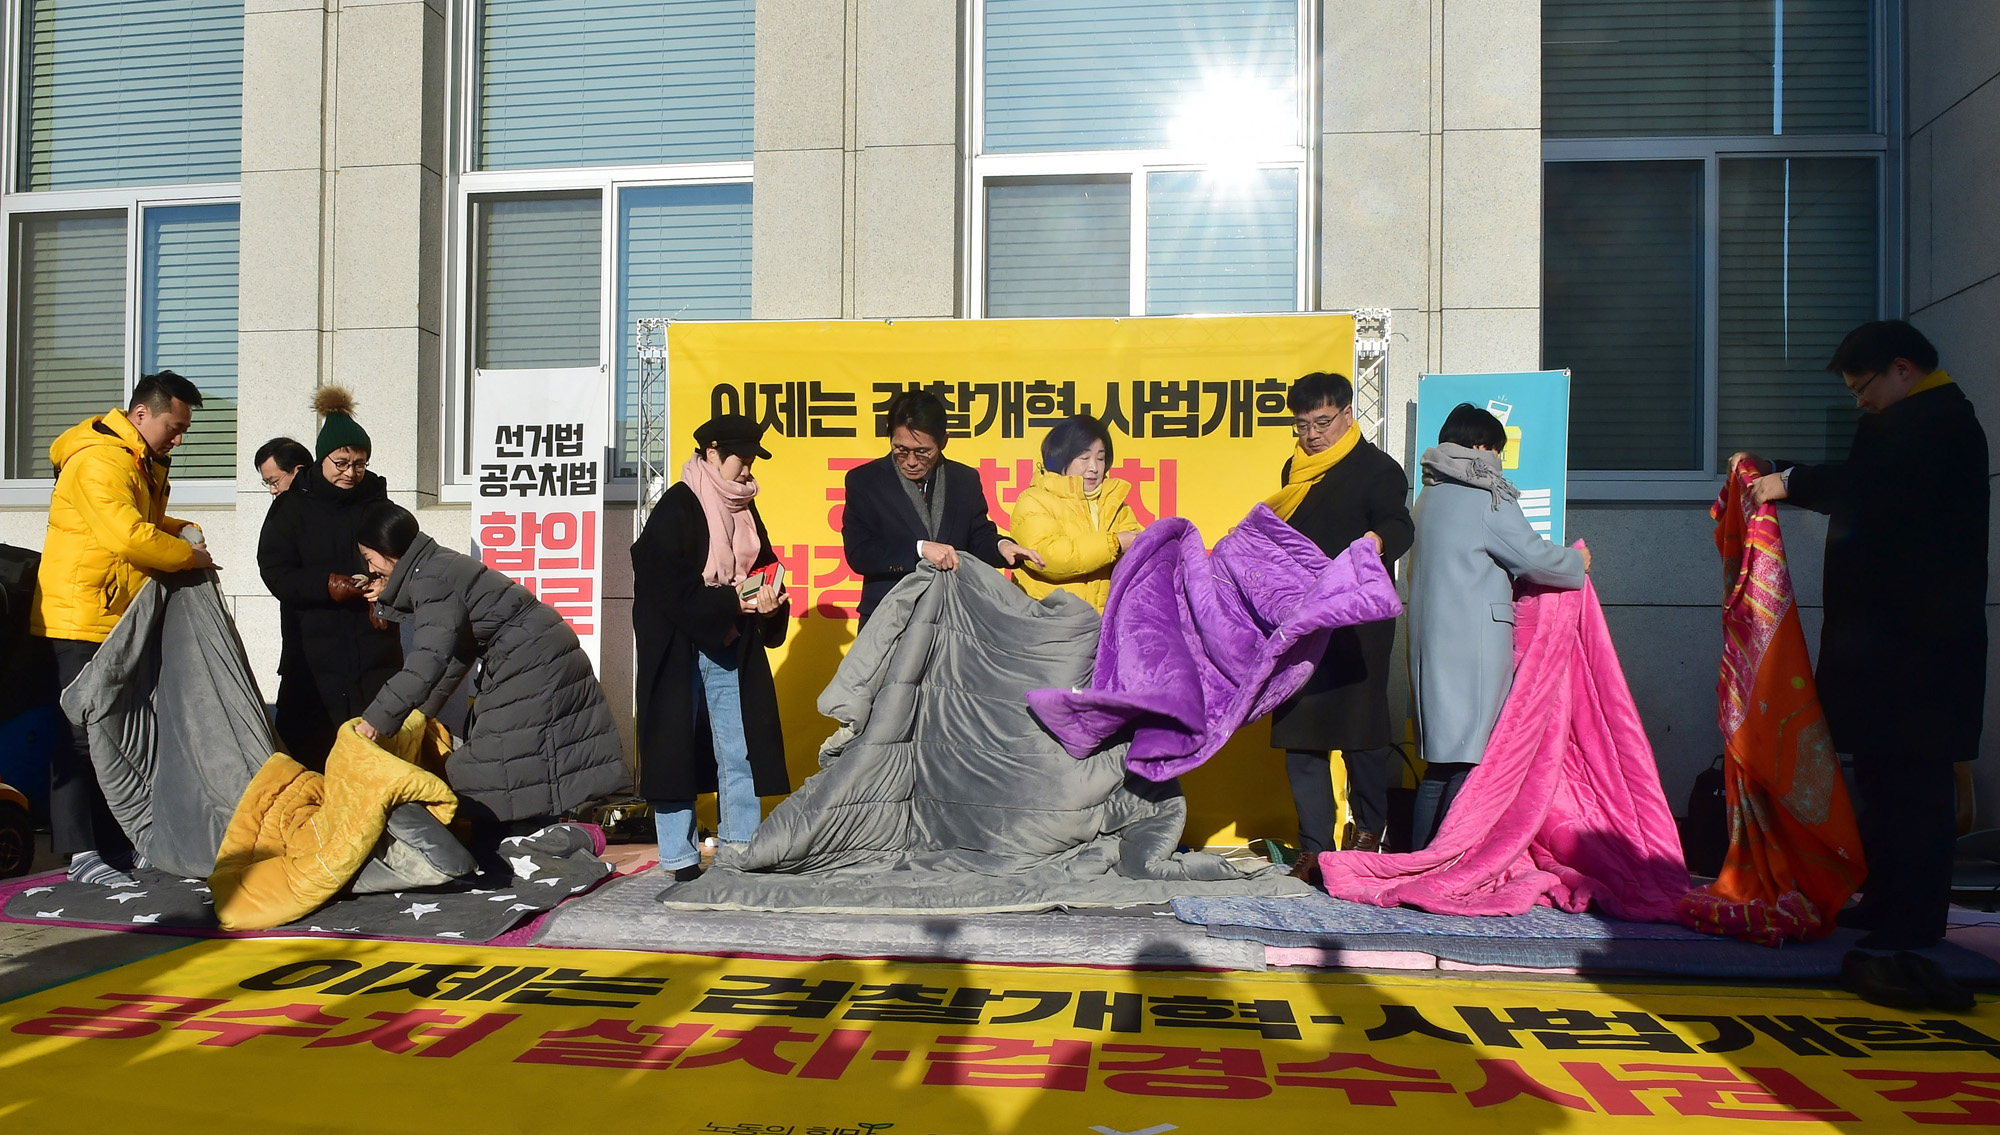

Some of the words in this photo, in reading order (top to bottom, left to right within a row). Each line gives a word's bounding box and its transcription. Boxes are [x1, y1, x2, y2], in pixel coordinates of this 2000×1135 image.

[710, 381, 857, 438] 이제는
[495, 423, 584, 458] 선거법
[480, 461, 597, 497] 공수처법
[480, 511, 596, 571] 합의
[513, 577, 594, 635] 로
[238, 959, 669, 1009] 이제는
[11, 992, 524, 1058] 공수처
